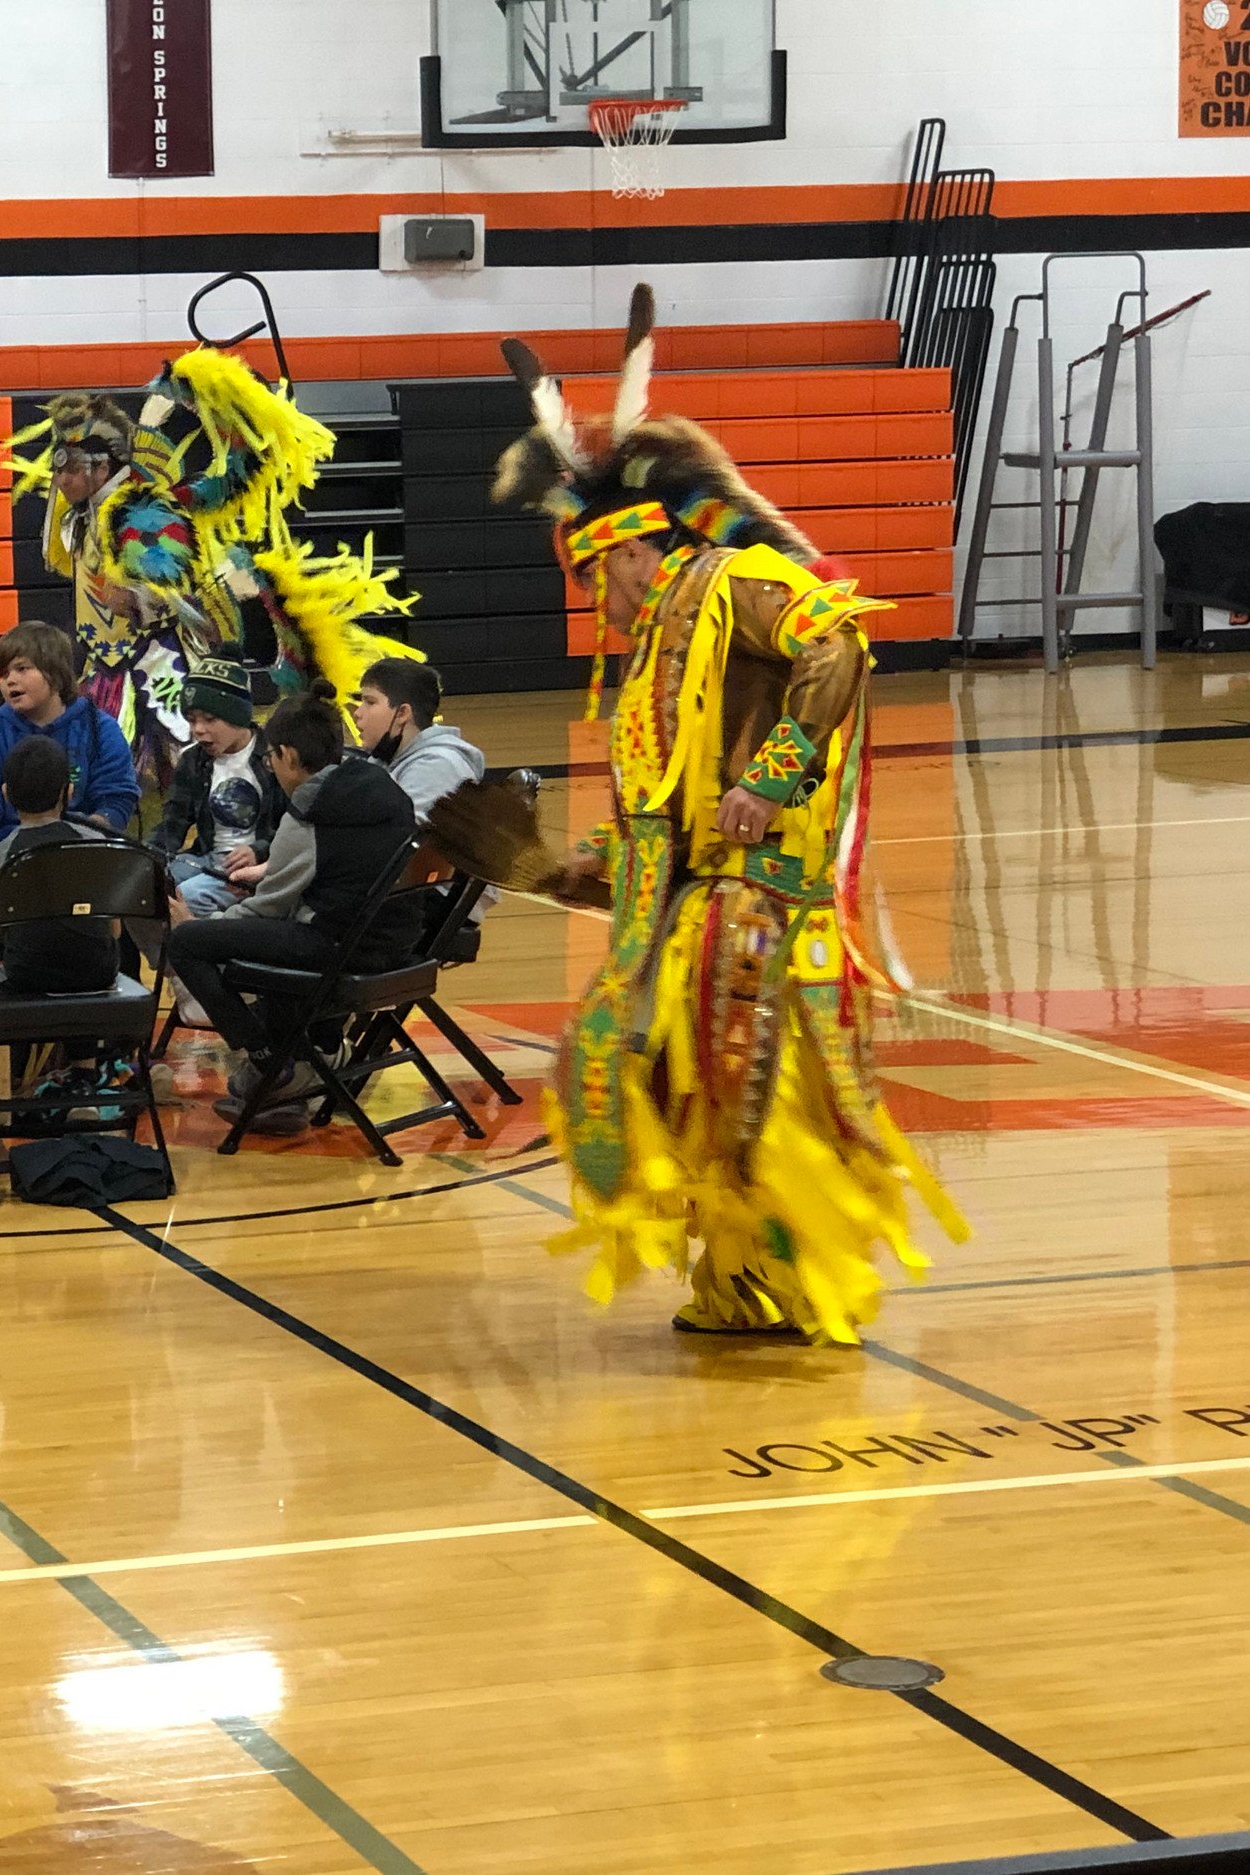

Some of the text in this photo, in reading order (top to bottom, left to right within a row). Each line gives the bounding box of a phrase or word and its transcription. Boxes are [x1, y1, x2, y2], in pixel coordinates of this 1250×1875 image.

[153, 50, 168, 168] SPRINGS
[1200, 101, 1250, 128] CH
[194, 661, 231, 678] CKS
[722, 1431, 994, 1479] JOHN
[1182, 1404, 1250, 1437] P
